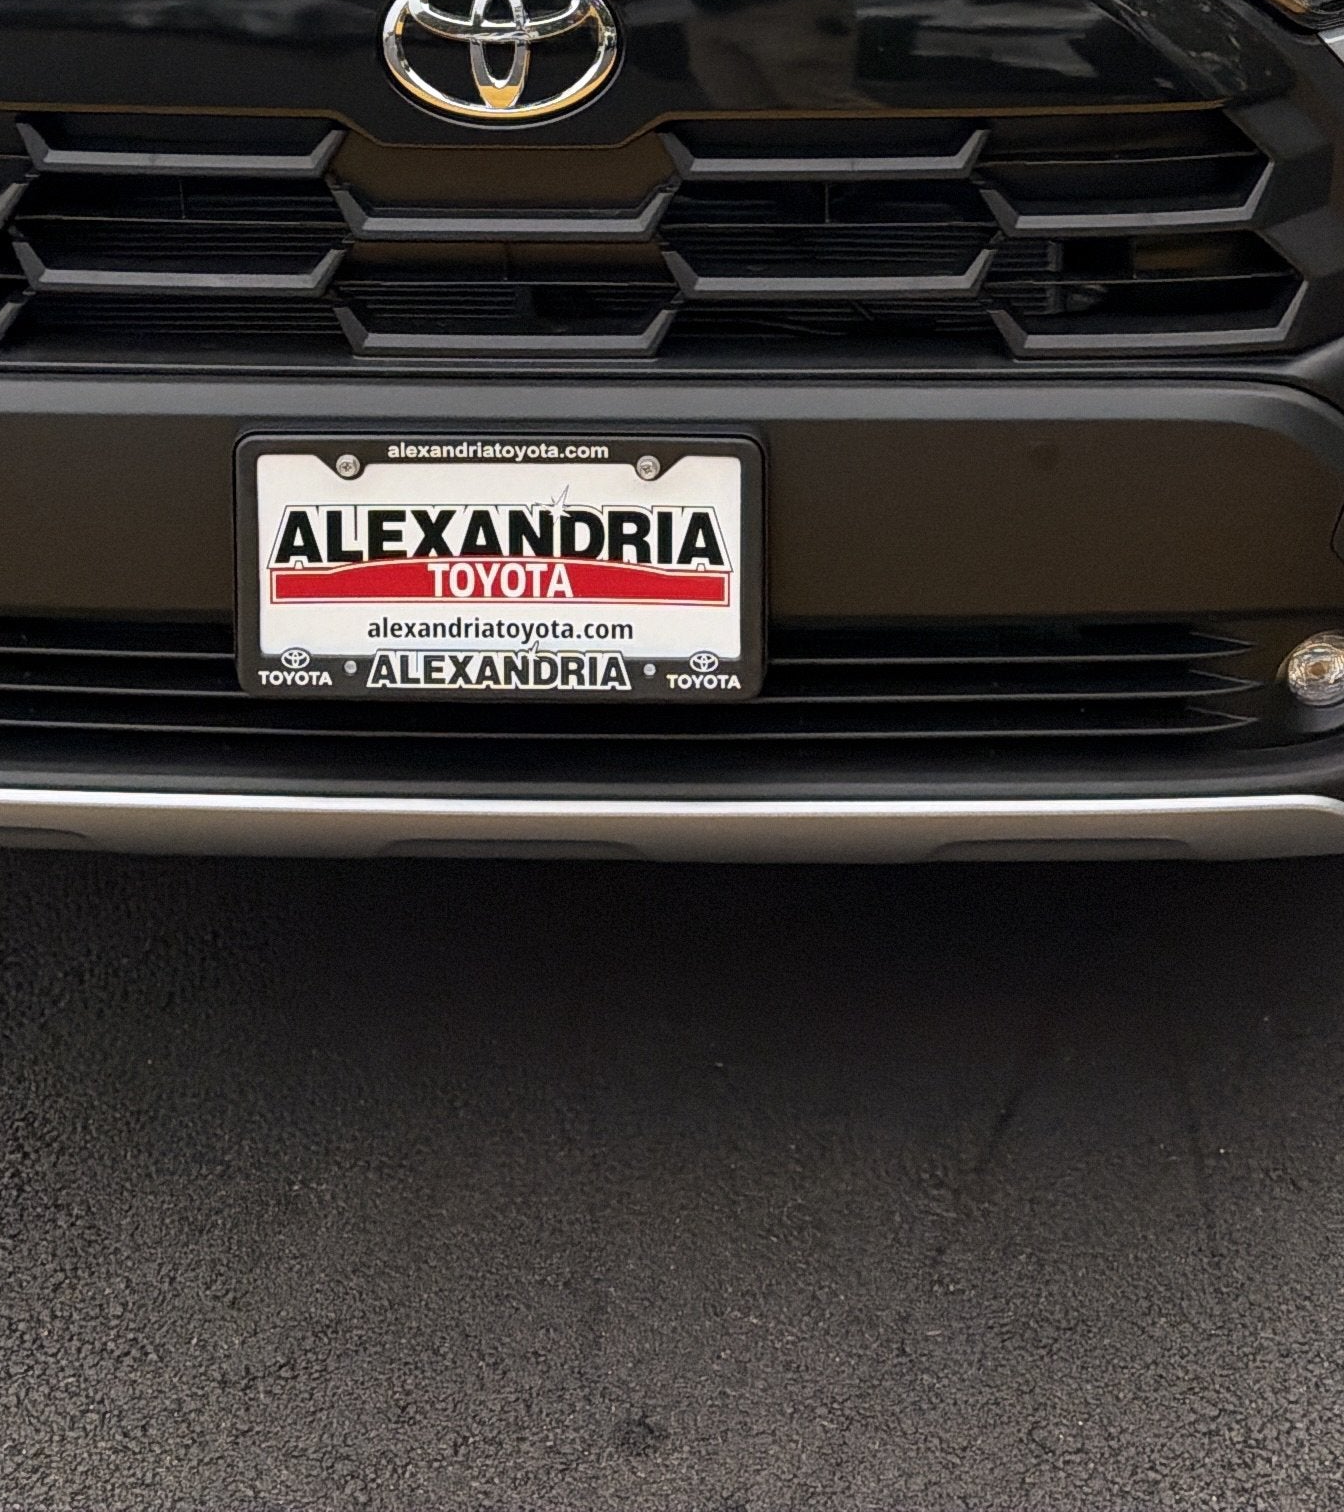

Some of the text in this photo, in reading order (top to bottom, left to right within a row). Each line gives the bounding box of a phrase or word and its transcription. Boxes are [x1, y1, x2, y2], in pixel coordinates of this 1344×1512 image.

[387, 442, 609, 462] alexandriatoyota.com
[273, 507, 726, 568] ALEXANDRIA
[427, 563, 574, 598] TOYOTA
[367, 617, 634, 644] alexandriatoyota.com
[258, 670, 332, 686] TOYOTA
[367, 652, 630, 688] ALEXANDRIA
[666, 674, 741, 690] TOYOTA
